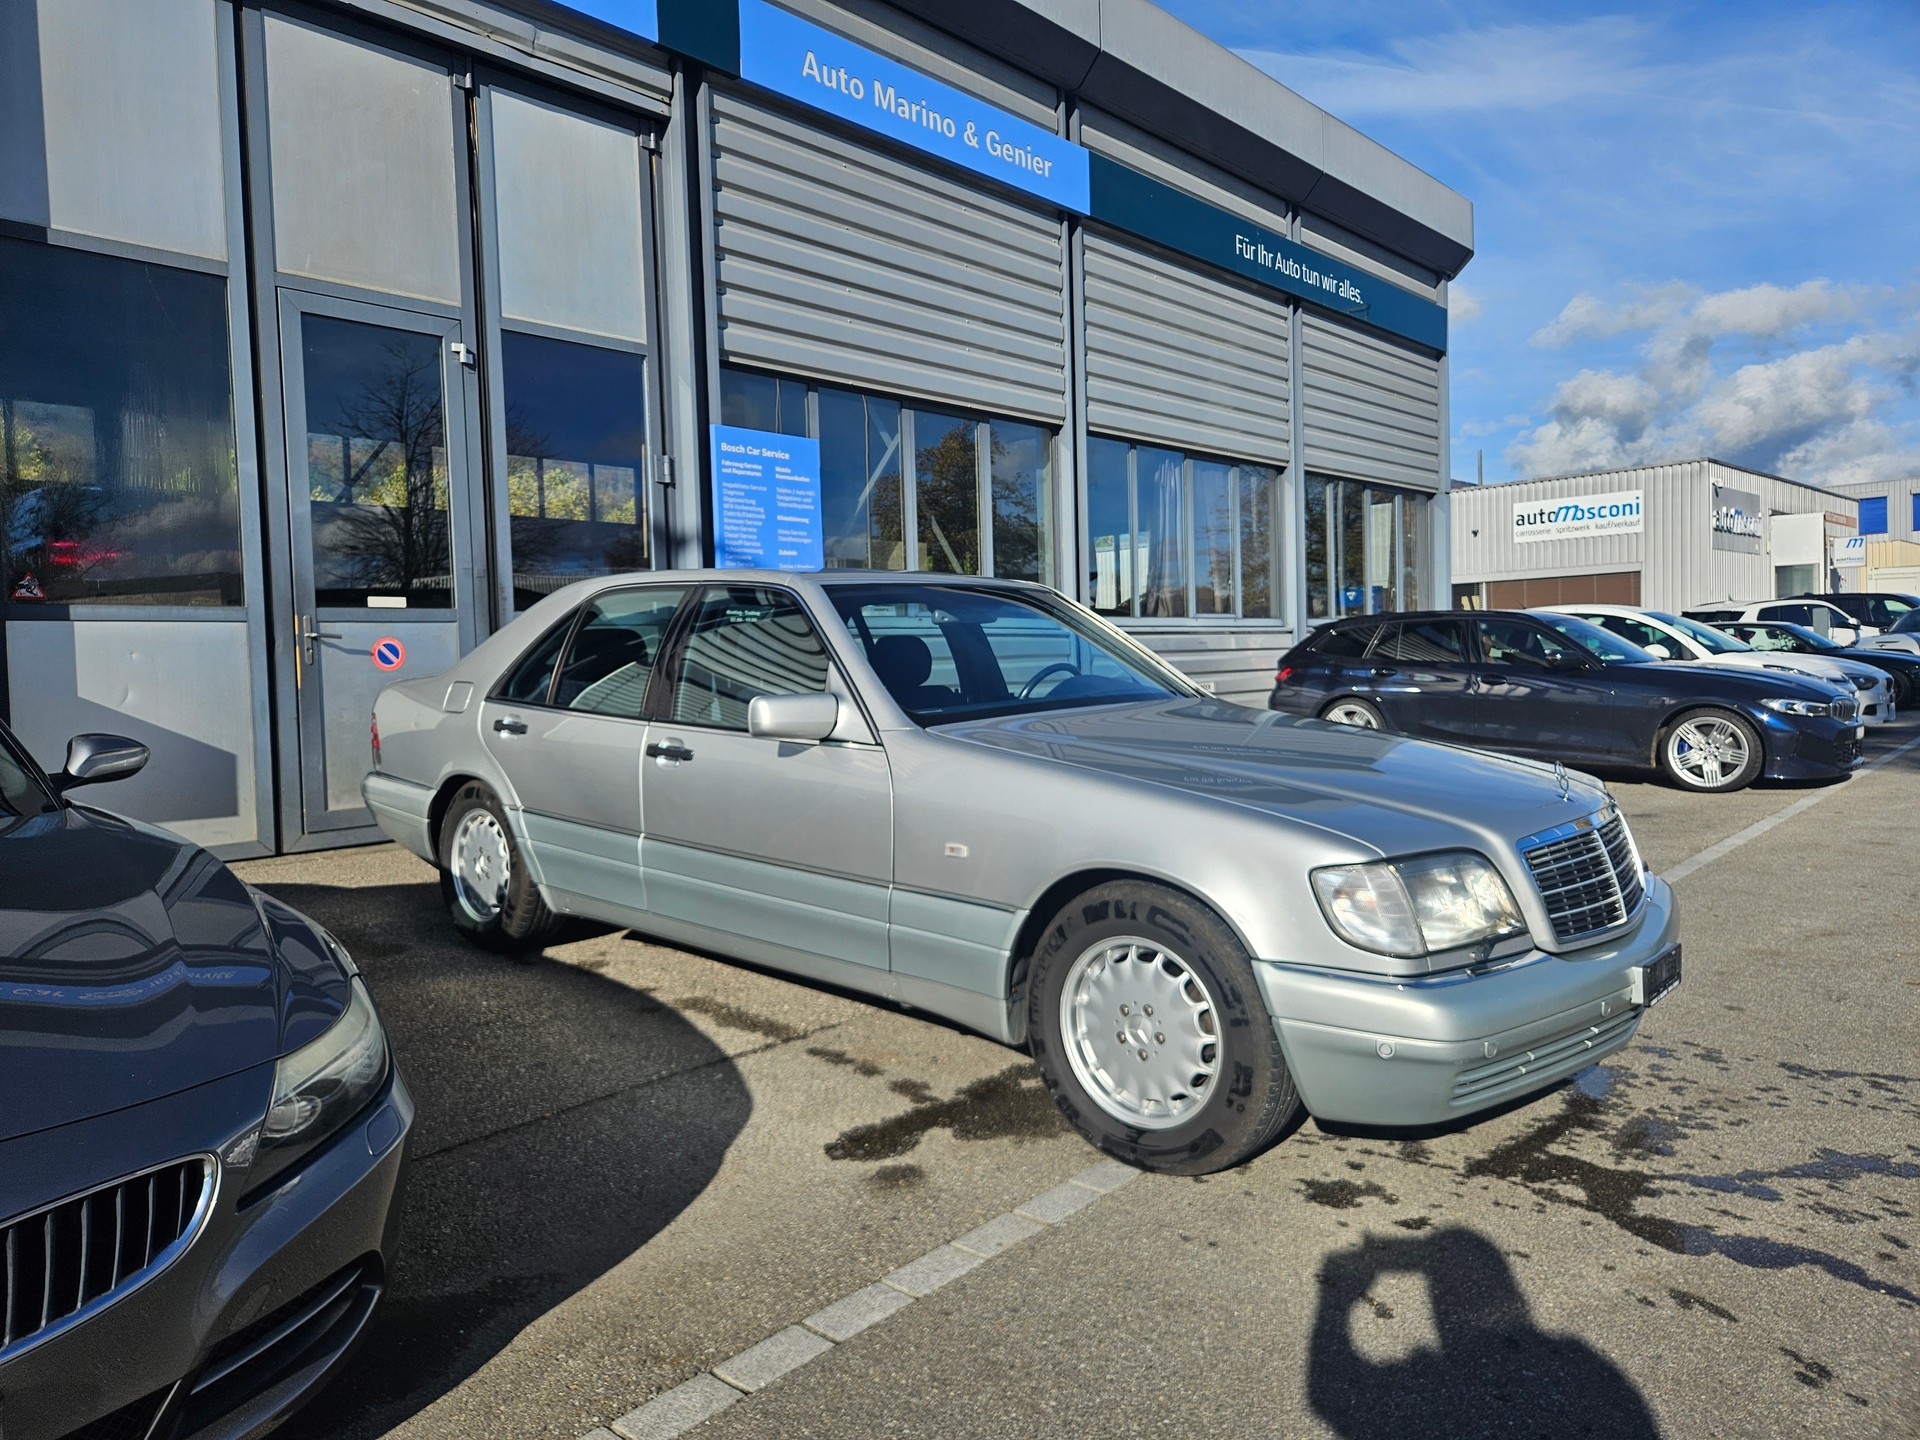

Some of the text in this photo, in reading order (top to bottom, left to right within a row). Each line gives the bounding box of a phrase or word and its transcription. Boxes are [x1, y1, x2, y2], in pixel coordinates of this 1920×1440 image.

[801, 50, 1052, 178] Auto Marino & Genier
[1235, 234, 1364, 304] Für Ihr Auto tun wir alles.
[721, 442, 790, 460] Bosch Car Service
[1556, 523, 1591, 535] spritzwerk
[1595, 517, 1641, 531] kauf/verkauf
